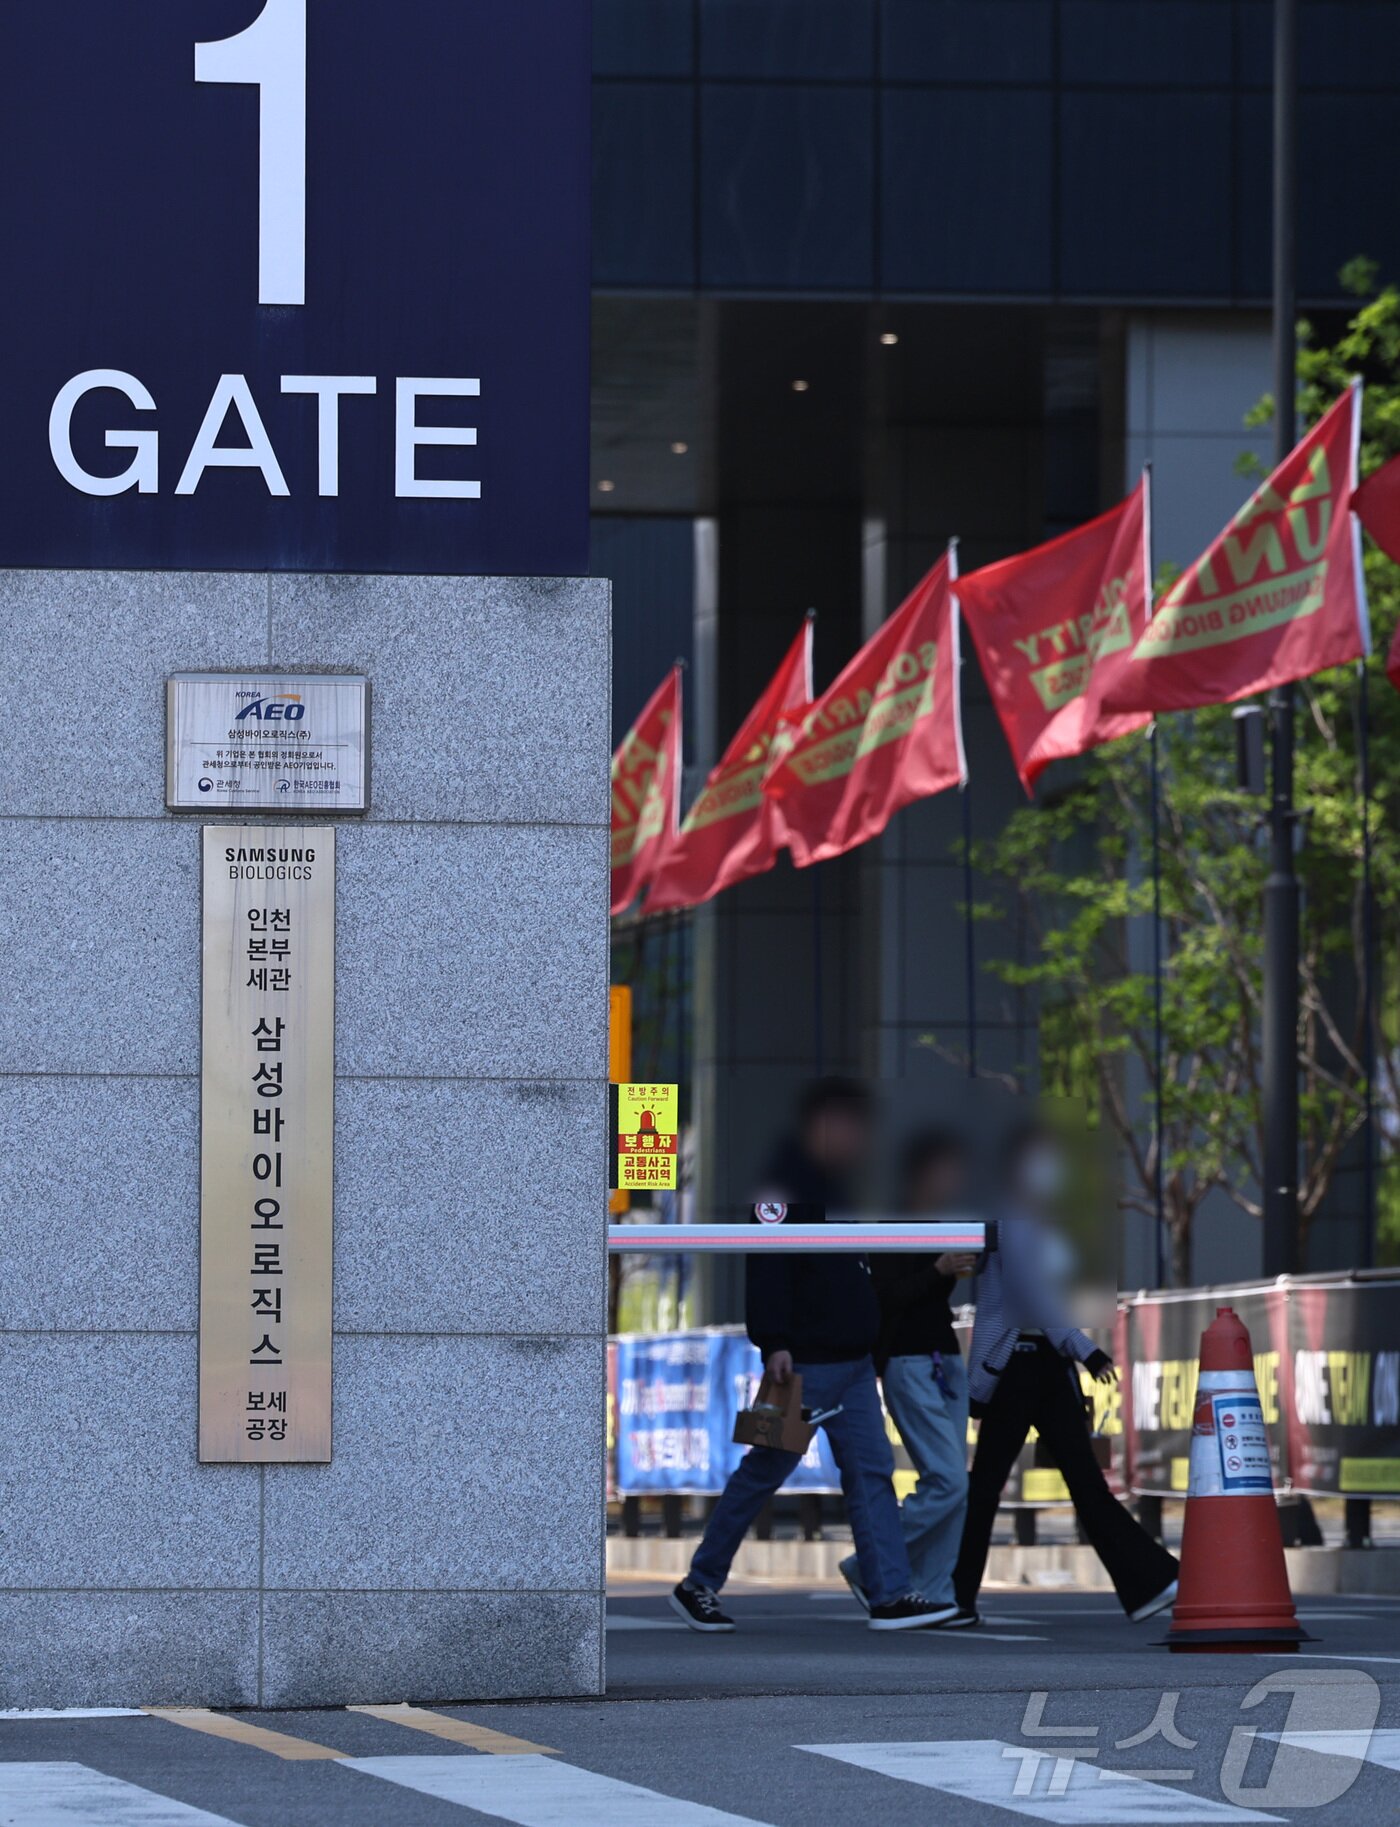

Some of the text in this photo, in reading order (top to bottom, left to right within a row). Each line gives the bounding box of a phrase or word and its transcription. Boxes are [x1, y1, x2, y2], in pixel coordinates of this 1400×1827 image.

[194, 0, 307, 305] 1
[48, 368, 482, 499] GATE
[234, 697, 305, 721] AEO
[228, 729, 311, 740] 삼성바이오로직스(주)
[202, 760, 252, 769] 관세청으로부터
[216, 750, 223, 759] 위
[225, 750, 247, 759] 기업은
[248, 751, 256, 759] 본
[257, 751, 279, 760] 협회의
[216, 780, 241, 789] 관세청
[225, 848, 316, 862] SAMSUNG
[229, 865, 312, 880] BIOLOGICS
[247, 908, 291, 932] 인천
[246, 938, 291, 962] 본부
[246, 968, 291, 991] 세관
[624, 1156, 671, 1168] 교통사고
[624, 1169, 671, 1180] 위험지역
[250, 1017, 286, 1365] 삼성바이오로직스
[246, 1391, 287, 1413] 보세
[246, 1418, 288, 1440] 공장
